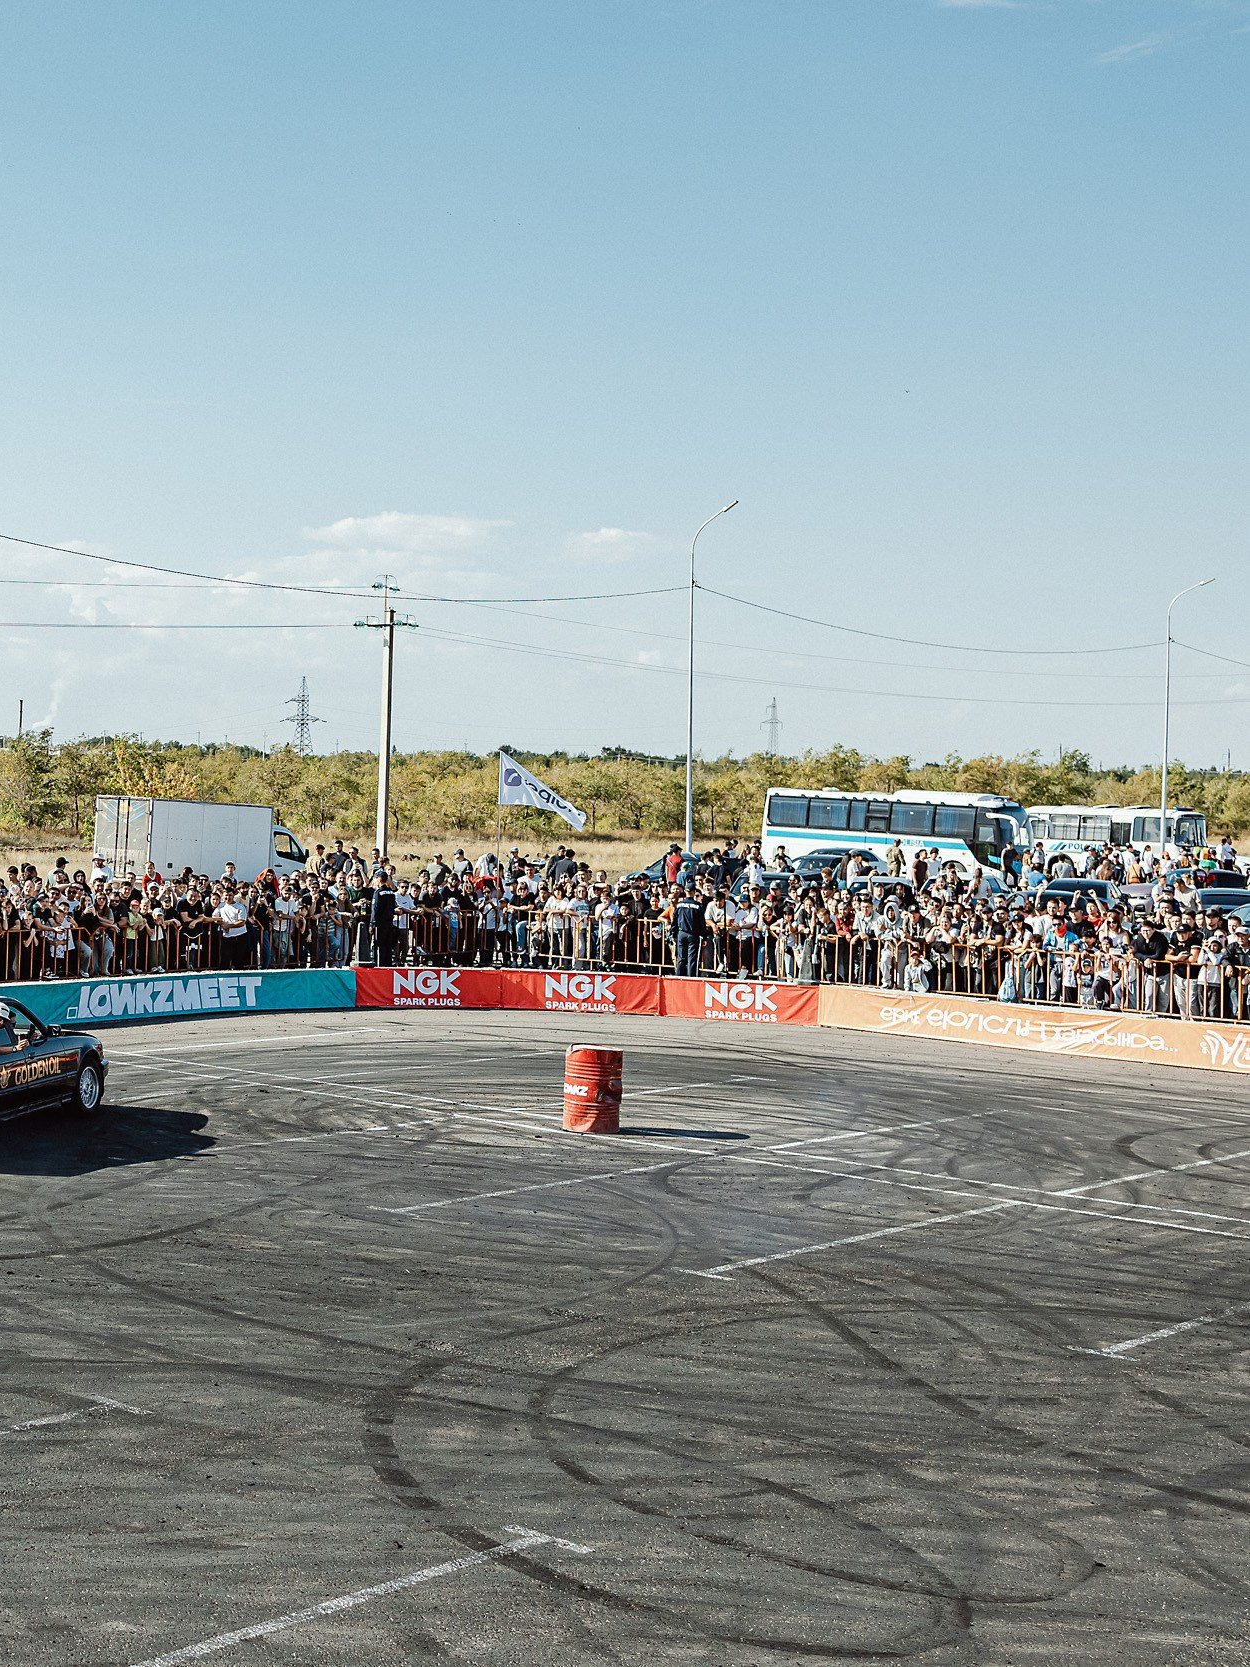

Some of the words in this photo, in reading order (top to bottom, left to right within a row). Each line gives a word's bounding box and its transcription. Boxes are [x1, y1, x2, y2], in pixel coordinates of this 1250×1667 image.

[900, 838, 925, 848] OLISIA
[1067, 842, 1103, 852] POLSIA
[393, 970, 461, 996] NGK
[545, 974, 617, 1001] NGK
[393, 997, 426, 1006] SPARK
[428, 997, 461, 1006] PLUGS
[704, 982, 779, 1012] NGK
[545, 1001, 578, 1010] SPARK
[581, 1002, 616, 1012] PLUGS
[705, 1010, 739, 1020] SPARK
[741, 1012, 778, 1023] PLUGS
[564, 1083, 589, 1097] OWKZ
